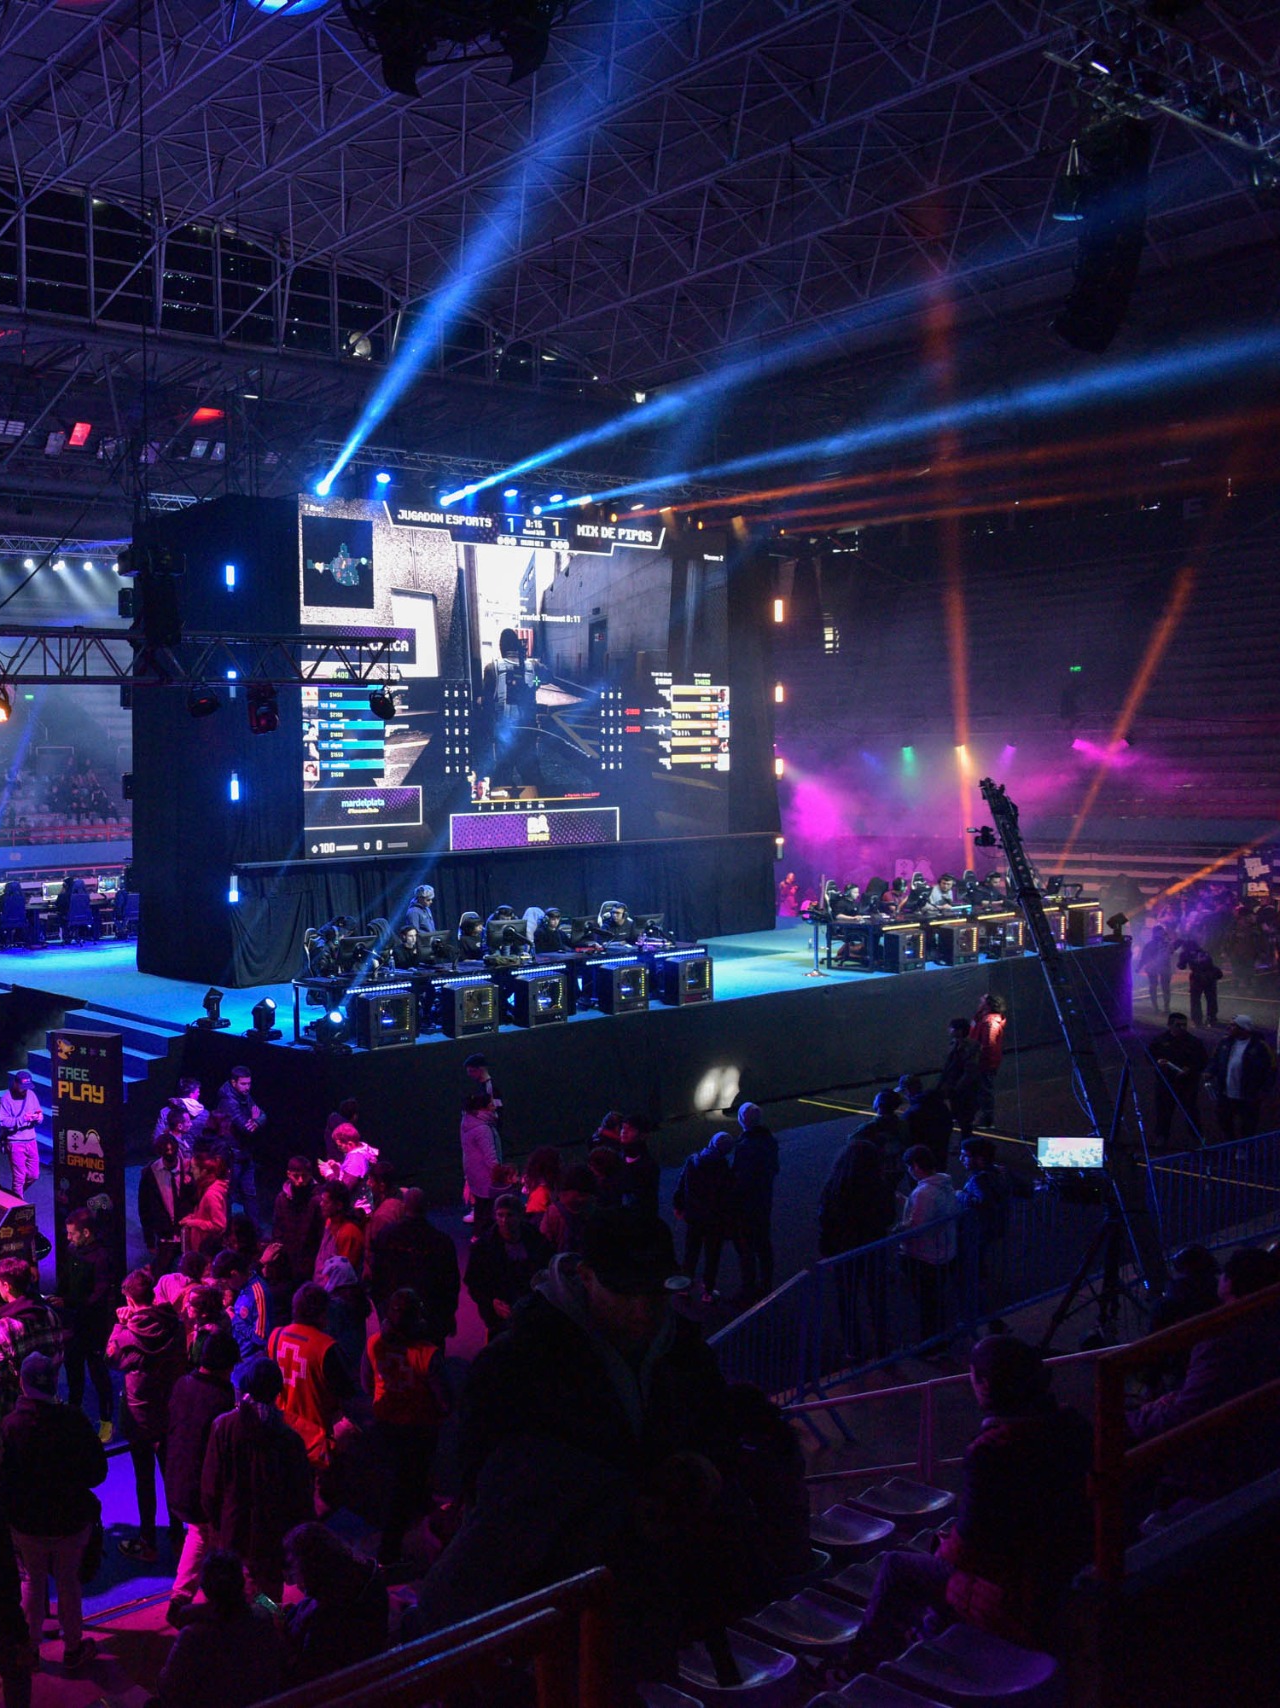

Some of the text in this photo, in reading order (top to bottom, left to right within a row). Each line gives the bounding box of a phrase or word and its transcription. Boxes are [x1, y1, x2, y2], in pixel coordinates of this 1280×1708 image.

[446, 515, 492, 528] ESPORTS
[507, 517, 515, 533] 1
[552, 521, 560, 537] 1
[577, 524, 653, 543] MIX DE PIPOS
[319, 842, 336, 853] 100
[376, 839, 383, 851] 0
[58, 1066, 89, 1081] FREE
[58, 1080, 104, 1104] PLAY
[67, 1129, 104, 1158] BA
[67, 1154, 105, 1171] GAMING
[86, 1171, 105, 1184] AGS
